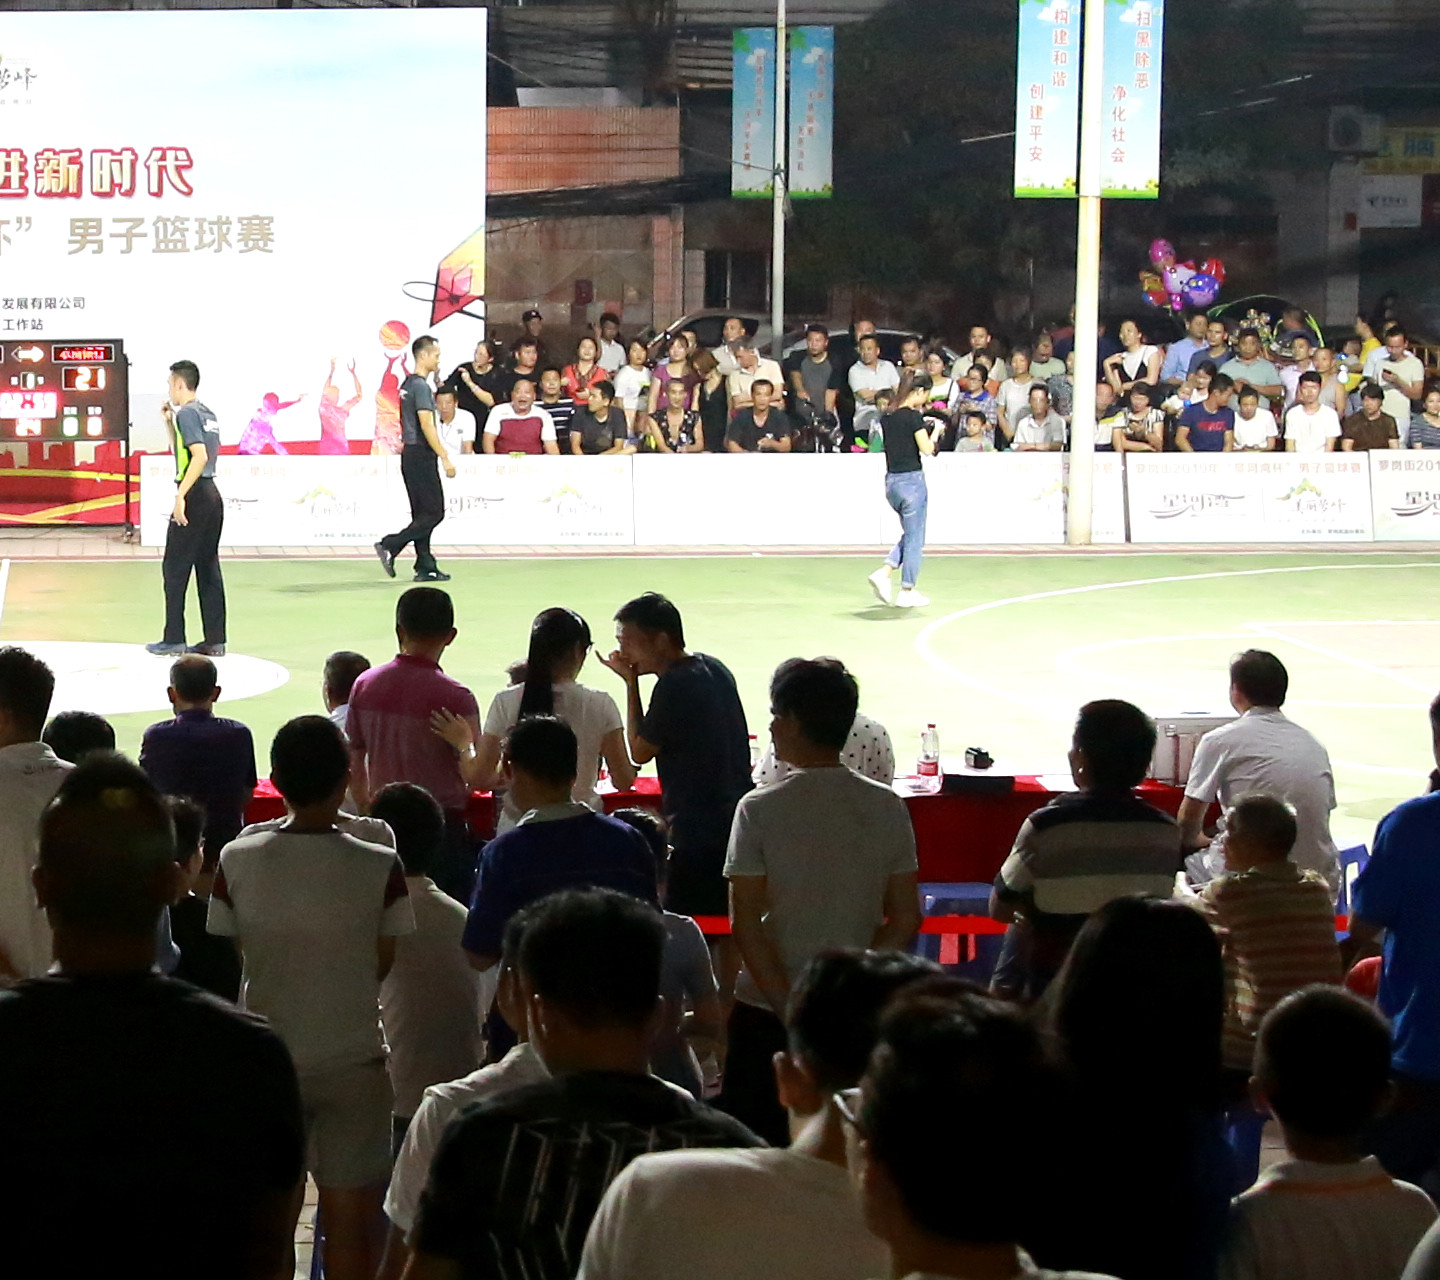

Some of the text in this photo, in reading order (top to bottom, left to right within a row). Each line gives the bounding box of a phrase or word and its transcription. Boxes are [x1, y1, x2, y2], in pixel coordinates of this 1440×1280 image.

[1052, 8, 1069, 88] 构建和谐
[1135, 10, 1152, 89] 扫黑除恶
[1029, 83, 1045, 162] 创建平安
[1111, 85, 1128, 163] 净化社会
[68, 215, 275, 255] 男子篮球赛
